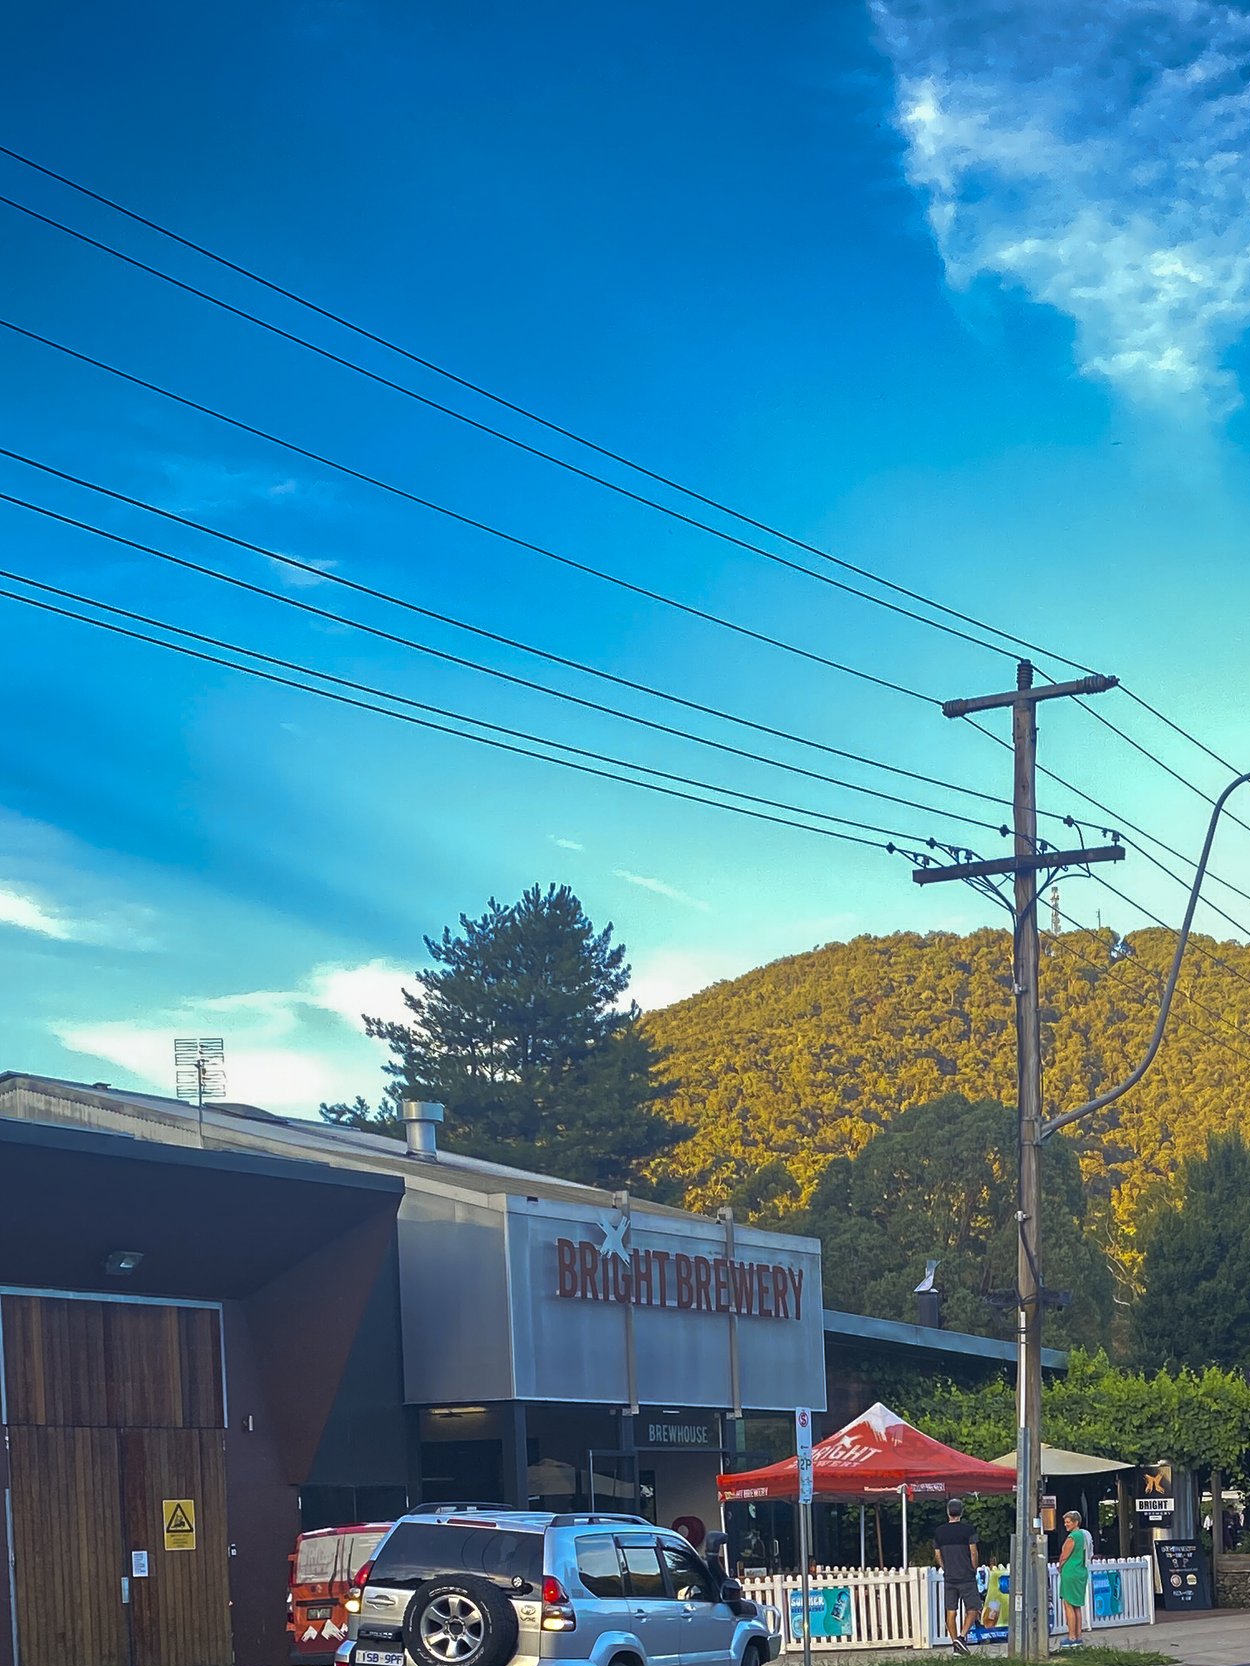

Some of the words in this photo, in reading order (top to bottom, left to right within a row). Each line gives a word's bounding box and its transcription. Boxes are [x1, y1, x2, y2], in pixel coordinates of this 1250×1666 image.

[556, 1237, 670, 1308] BRIGHT
[675, 1252, 804, 1321] BREWERY
[648, 1423, 709, 1443] BREWHOUSE
[812, 1443, 883, 1463] RIGHT
[800, 1458, 812, 1471] 2P
[1139, 1500, 1168, 1510] BRIGHT
[384, 1653, 404, 1665] 9PF
